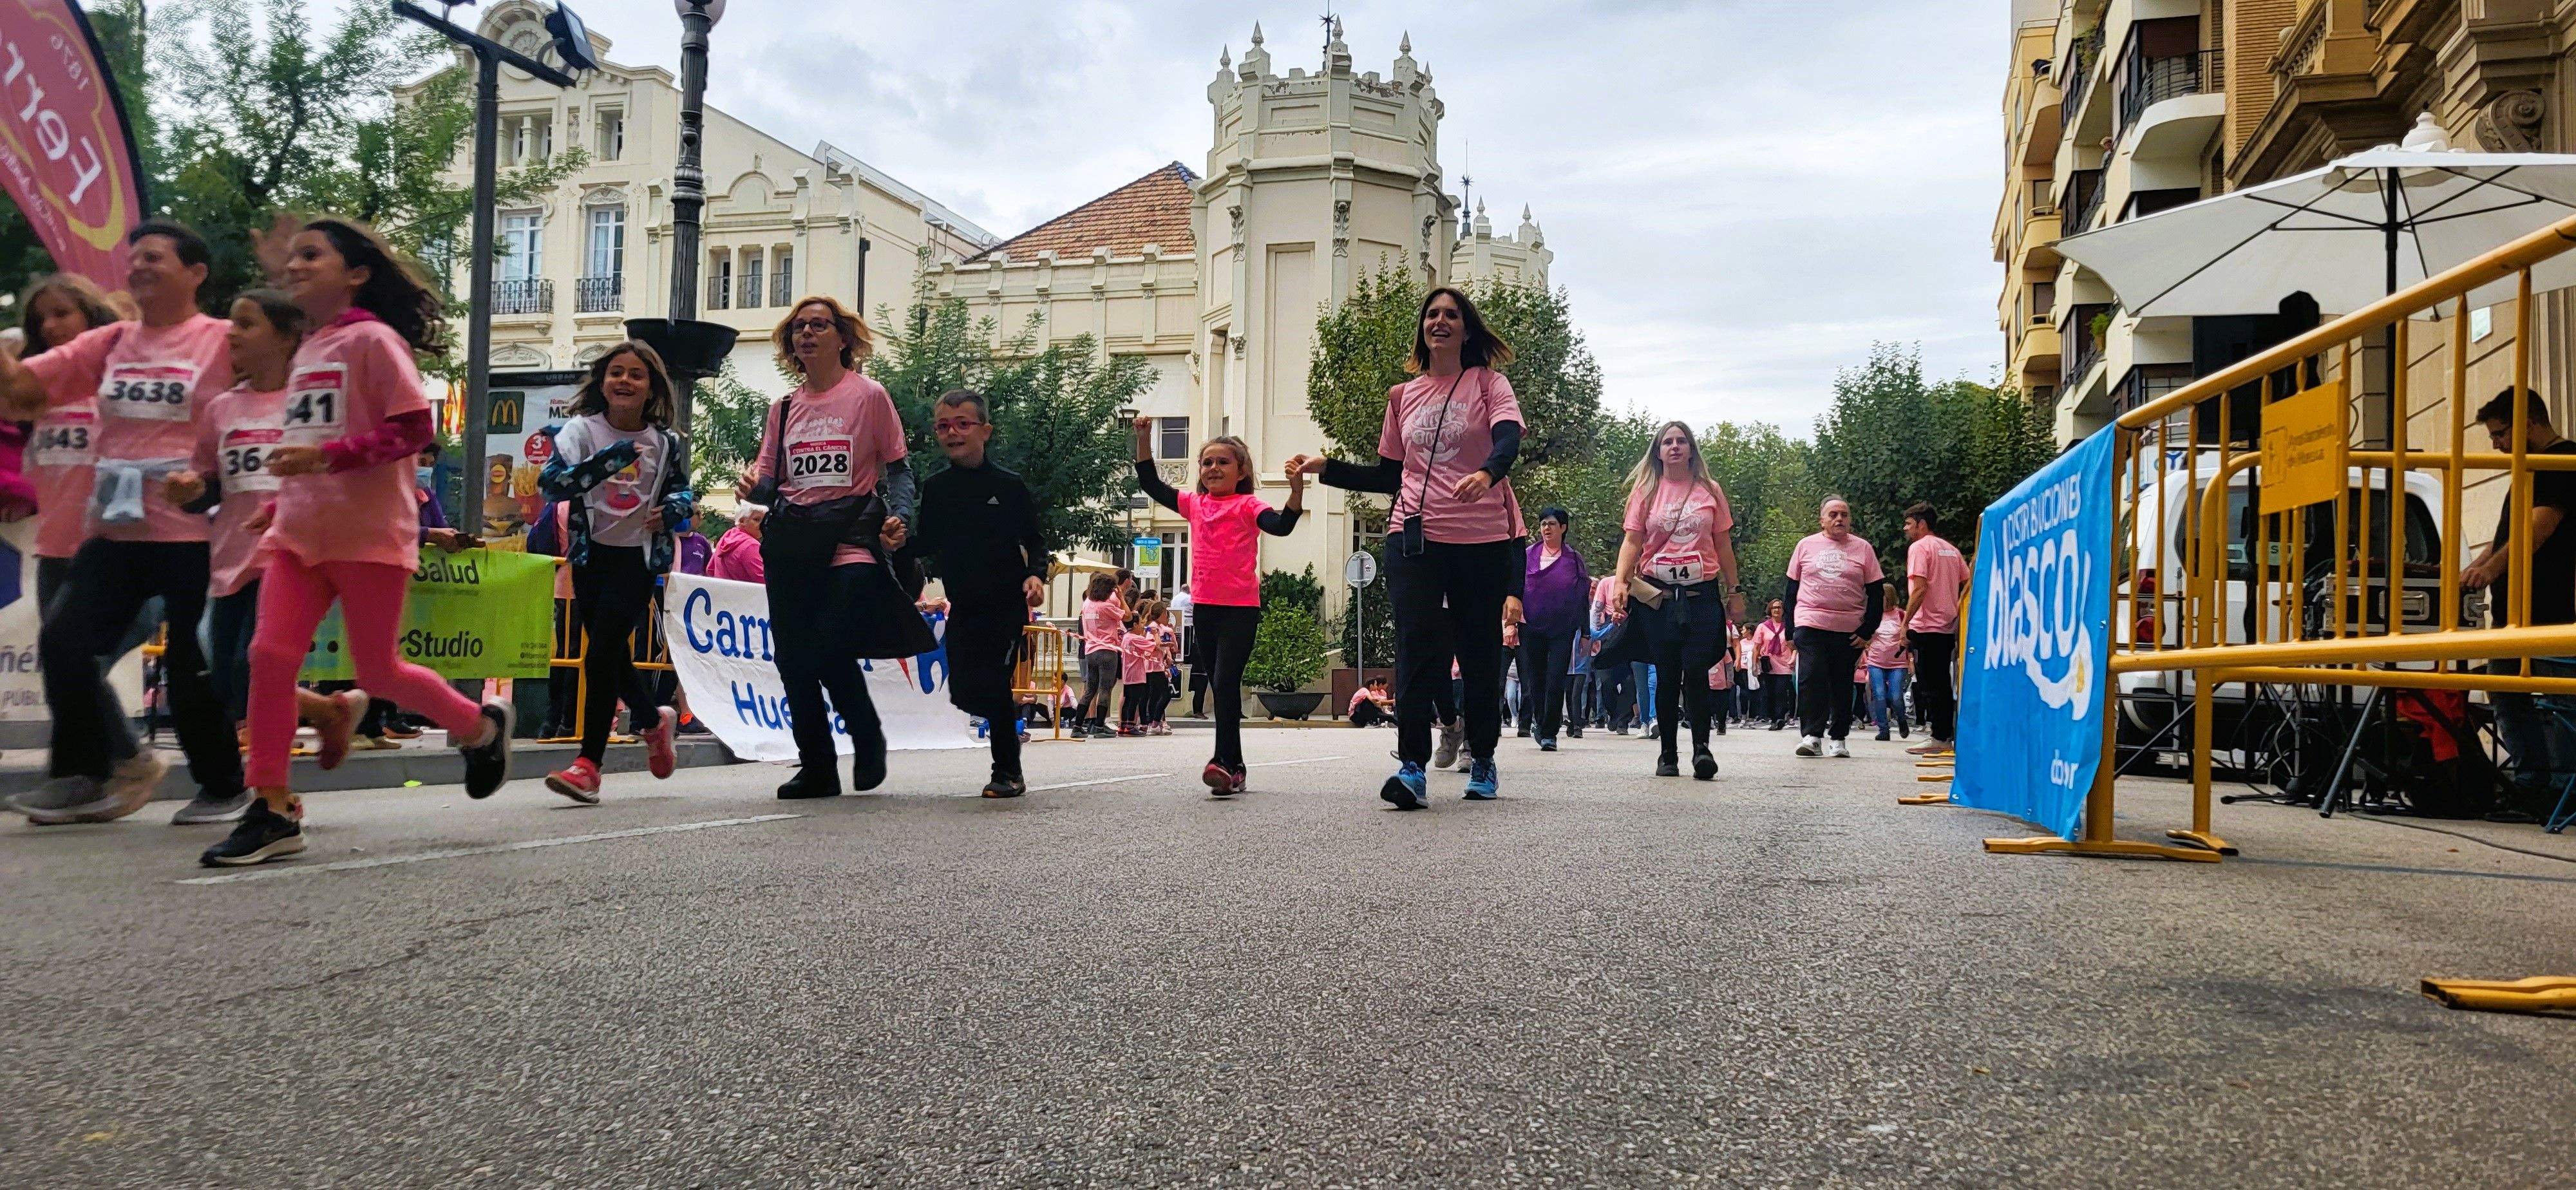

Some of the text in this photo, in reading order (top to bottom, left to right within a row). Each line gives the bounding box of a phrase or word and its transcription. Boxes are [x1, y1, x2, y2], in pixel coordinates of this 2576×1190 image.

[107, 380, 185, 405] 3638
[549, 406, 575, 419] ME
[226, 447, 274, 475] 36
[793, 453, 848, 477] 2028
[413, 557, 480, 585] Salud
[1669, 565, 1690, 580] 14
[683, 587, 775, 662] Carr
